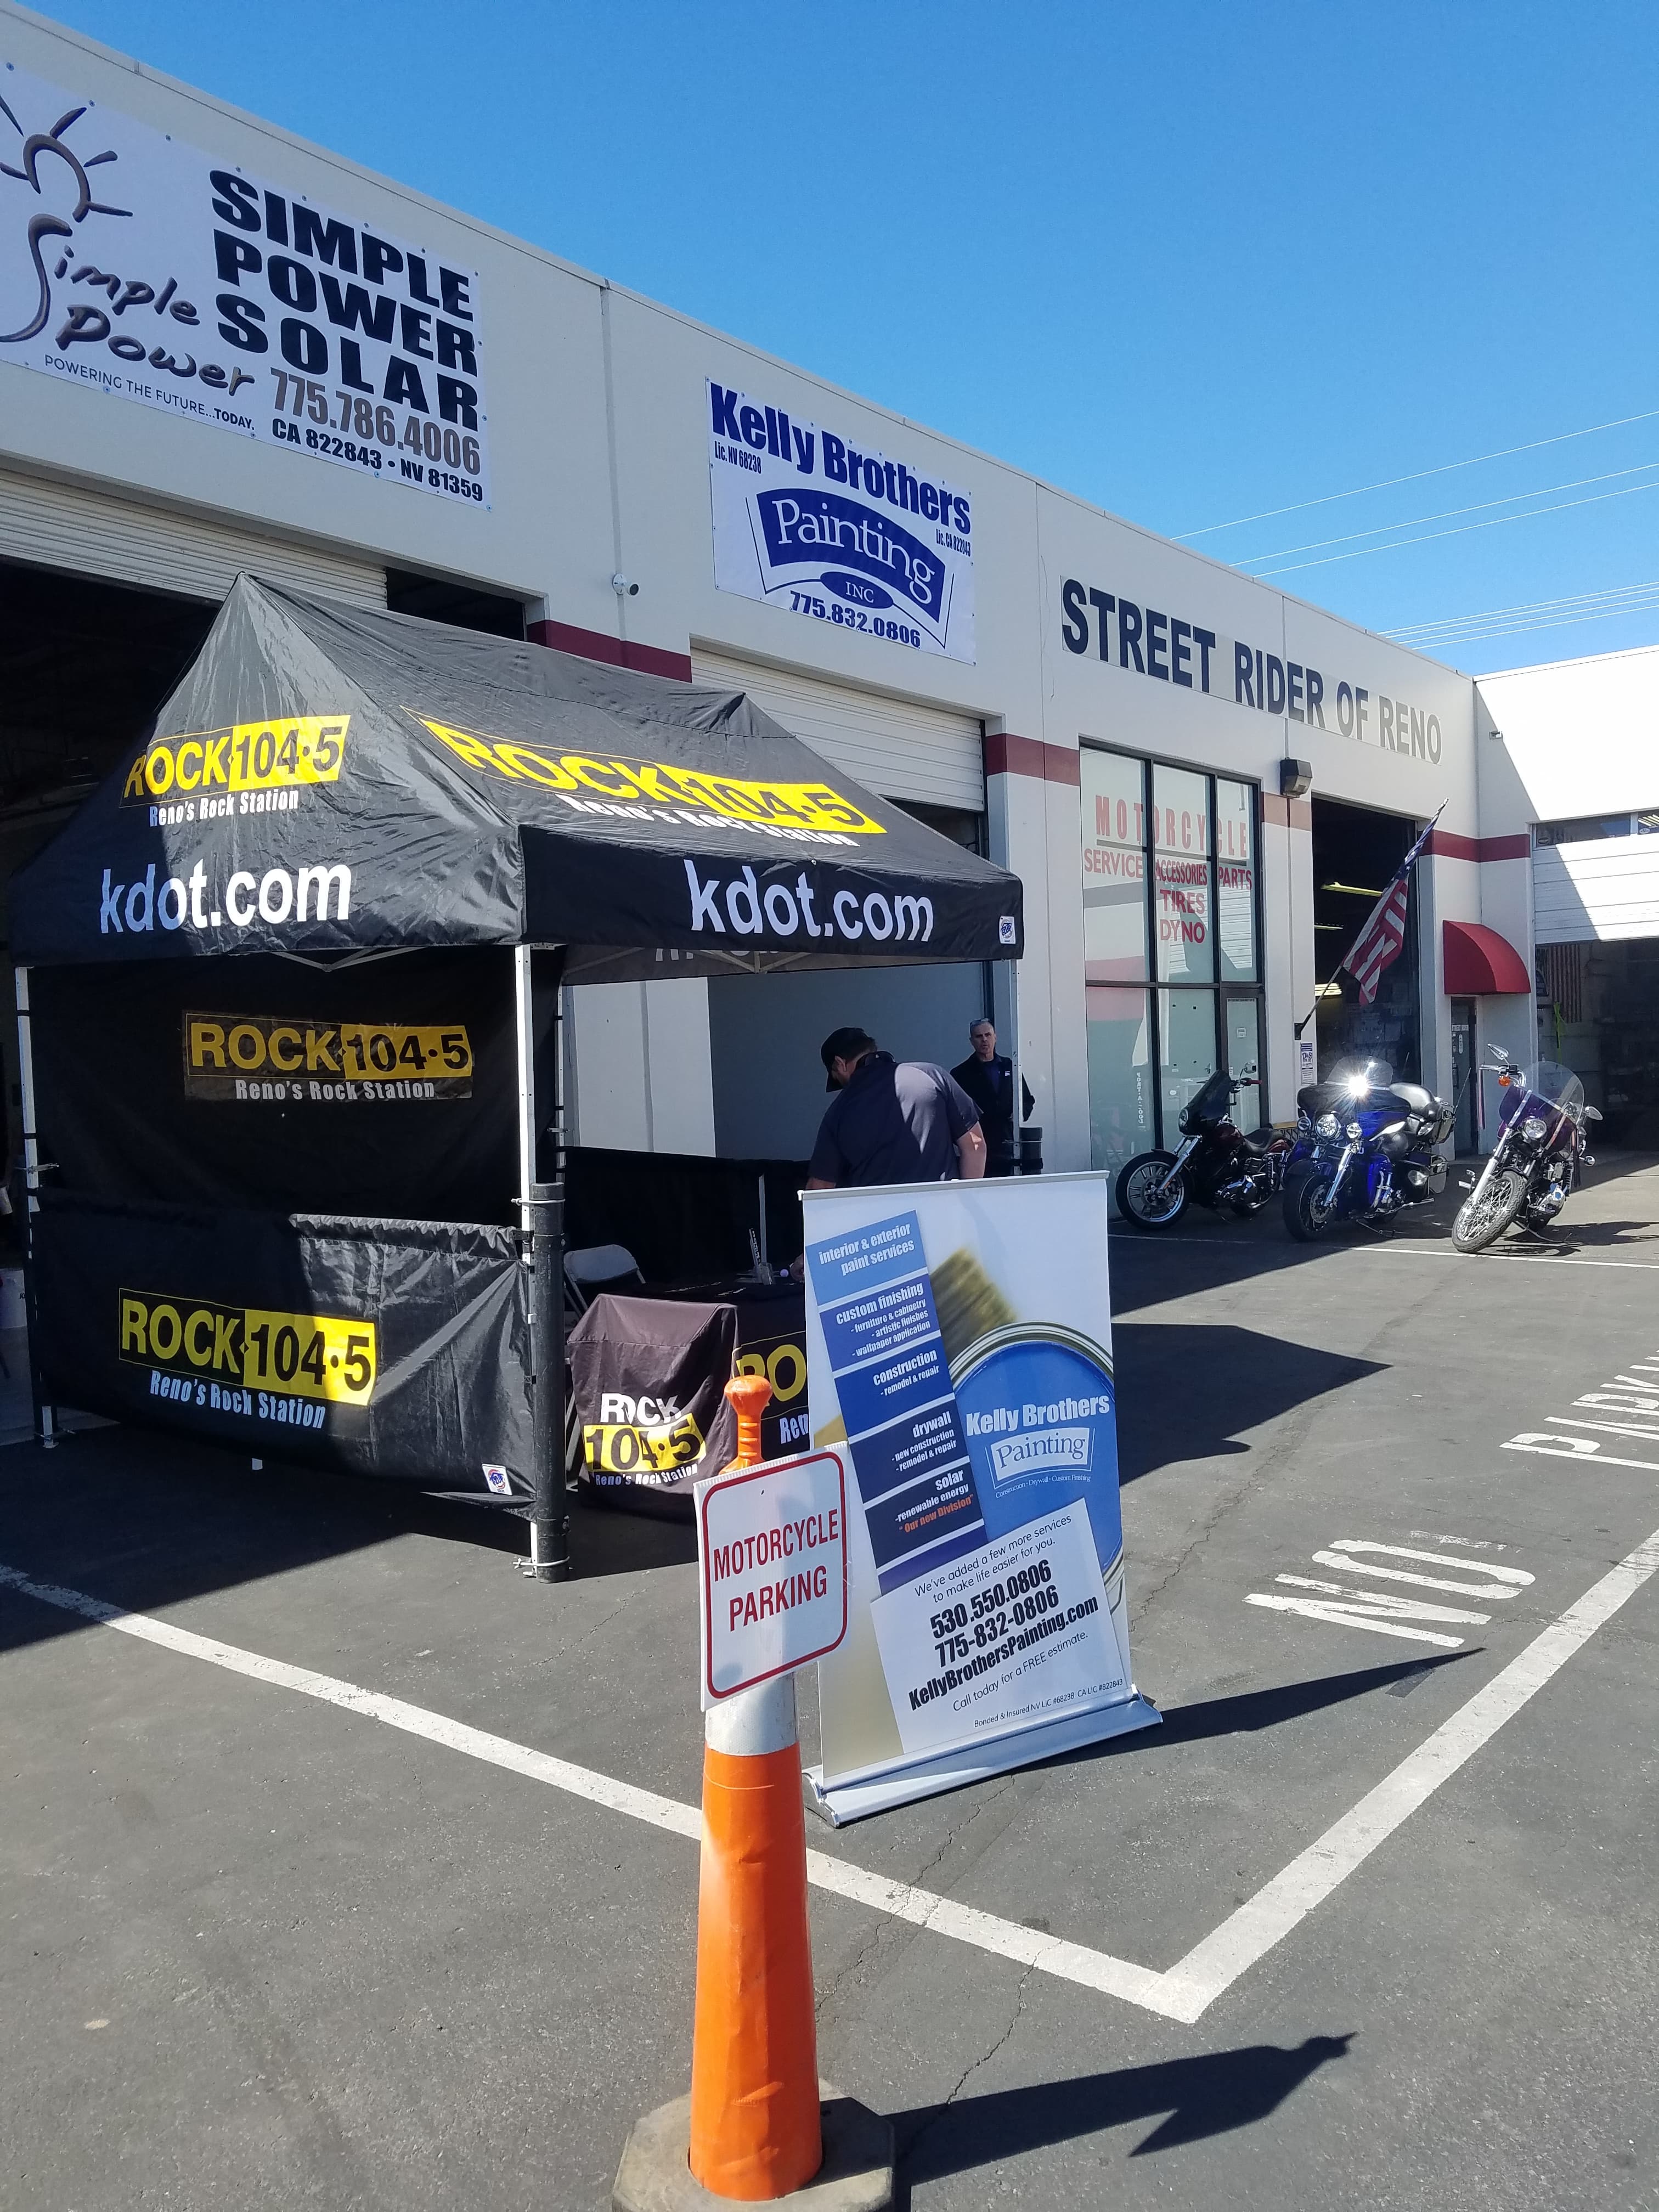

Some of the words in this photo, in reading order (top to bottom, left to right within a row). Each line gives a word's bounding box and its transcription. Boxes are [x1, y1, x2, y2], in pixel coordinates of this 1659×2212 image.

[210, 170, 473, 323] SIMPLE
[0, 213, 200, 343] Simple
[213, 228, 478, 377] POWER
[55, 304, 255, 396] Power
[216, 293, 478, 432] SOLAR
[44, 355, 122, 389] POWERING
[126, 380, 153, 401] THE
[270, 368, 481, 475] 775.786.4006
[272, 418, 301, 445] CA
[306, 429, 382, 470] 822843
[401, 461, 424, 483] NV
[428, 472, 483, 502] 81359
[710, 382, 815, 475] Kelly
[821, 430, 971, 535] Brothers
[715, 441, 727, 462] Lic.
[728, 445, 738, 466] NV
[738, 449, 761, 474] 68238
[772, 499, 935, 604] Painting
[936, 529, 944, 546] Lic.
[946, 533, 953, 550] CA
[953, 535, 971, 557] 822843
[845, 580, 874, 603] INC
[789, 590, 921, 648] 775.832.0806
[1062, 579, 1216, 693] STREET
[1235, 640, 1325, 729] RIDER
[1336, 680, 1368, 740] OF
[1378, 695, 1441, 764] RENO
[124, 736, 232, 799] ROCK
[421, 718, 704, 807] ROCK
[149, 799, 195, 827] Reno's
[199, 795, 234, 819] Rock
[239, 789, 299, 814] Station
[1084, 848, 1143, 879] SERVICE
[1218, 866, 1252, 891] PARTS
[100, 858, 352, 934] kdot.com
[684, 859, 933, 942] kdot.com
[1159, 889, 1205, 914] TIRES
[1159, 921, 1205, 943] DYNO
[190, 1023, 341, 1072] ROCK
[235, 1079, 302, 1100] Reno's
[310, 1080, 357, 1100] Rock
[363, 1080, 435, 1099] Station
[819, 1240, 859, 1264] interior
[861, 1238, 870, 1250] &
[870, 1223, 911, 1248] exterior
[841, 1255, 870, 1276] paint
[870, 1239, 915, 1262] services
[836, 1300, 877, 1325] custom
[878, 1283, 924, 1305] finishing
[894, 1299, 926, 1318] cabinetry
[901, 1310, 928, 1328] finishes
[122, 1299, 241, 1373] ROCK
[893, 1321, 930, 1342] application
[873, 1350, 938, 1386] construction
[912, 1375, 918, 1383] &
[918, 1365, 939, 1380] repair
[150, 1370, 206, 1406] Reno's
[210, 1383, 252, 1416] Rock
[258, 1393, 326, 1429] Station
[966, 1408, 1018, 1436] Kelly
[1022, 1395, 1110, 1426] Brothers
[910, 1429, 955, 1453] construction
[912, 1411, 951, 1438] drywall
[935, 1440, 957, 1455] repair
[595, 1473, 632, 1486] Reno's
[635, 1472, 661, 1486] Rock
[661, 1463, 698, 1483] Station
[996, 1432, 1085, 1469] Painting
[935, 1470, 964, 1491] solar
[940, 1484, 969, 1502] energy
[996, 1482, 1025, 1499] Construction
[1029, 1476, 1048, 1486] Drywall
[1071, 1474, 1091, 1482] Finishing
[920, 1509, 936, 1526] new
[714, 1509, 839, 1583] MOTORCYCLE
[915, 1576, 946, 1596] We've
[948, 1558, 979, 1581] added
[981, 1556, 988, 1564] a
[989, 1547, 1007, 1561] few
[1009, 1533, 1032, 1550] more
[1034, 1515, 1071, 1537] services
[933, 1593, 944, 1603] to
[946, 1578, 974, 1596] make
[976, 1568, 990, 1583] life
[992, 1556, 1018, 1574] easier
[1020, 1547, 1034, 1562] for
[1035, 1539, 1056, 1556] you.
[1243, 1539, 1536, 1647] NO
[730, 1566, 828, 1633] PARKING
[930, 1559, 1052, 1639] 530.550.0806
[935, 1585, 1058, 1668] 775-832-0806
[909, 1597, 1098, 1711] KellyBrothersPainting.com
[953, 1695, 971, 1712] Call
[973, 1681, 998, 1704] today
[1001, 1672, 1013, 1685] for
[1023, 1654, 1046, 1672] FREE
[1047, 1632, 1088, 1656] estimate.
[974, 1716, 998, 1728] Bonded
[1007, 1706, 1029, 1718] Insured
[1031, 1701, 1040, 1711] NV
[1042, 1699, 1052, 1707] LIC
[1053, 1693, 1075, 1705] #68238
[1077, 1687, 1086, 1697] CA
[1088, 1686, 1097, 1694] LIC
[1098, 1679, 1123, 1691] #822843
